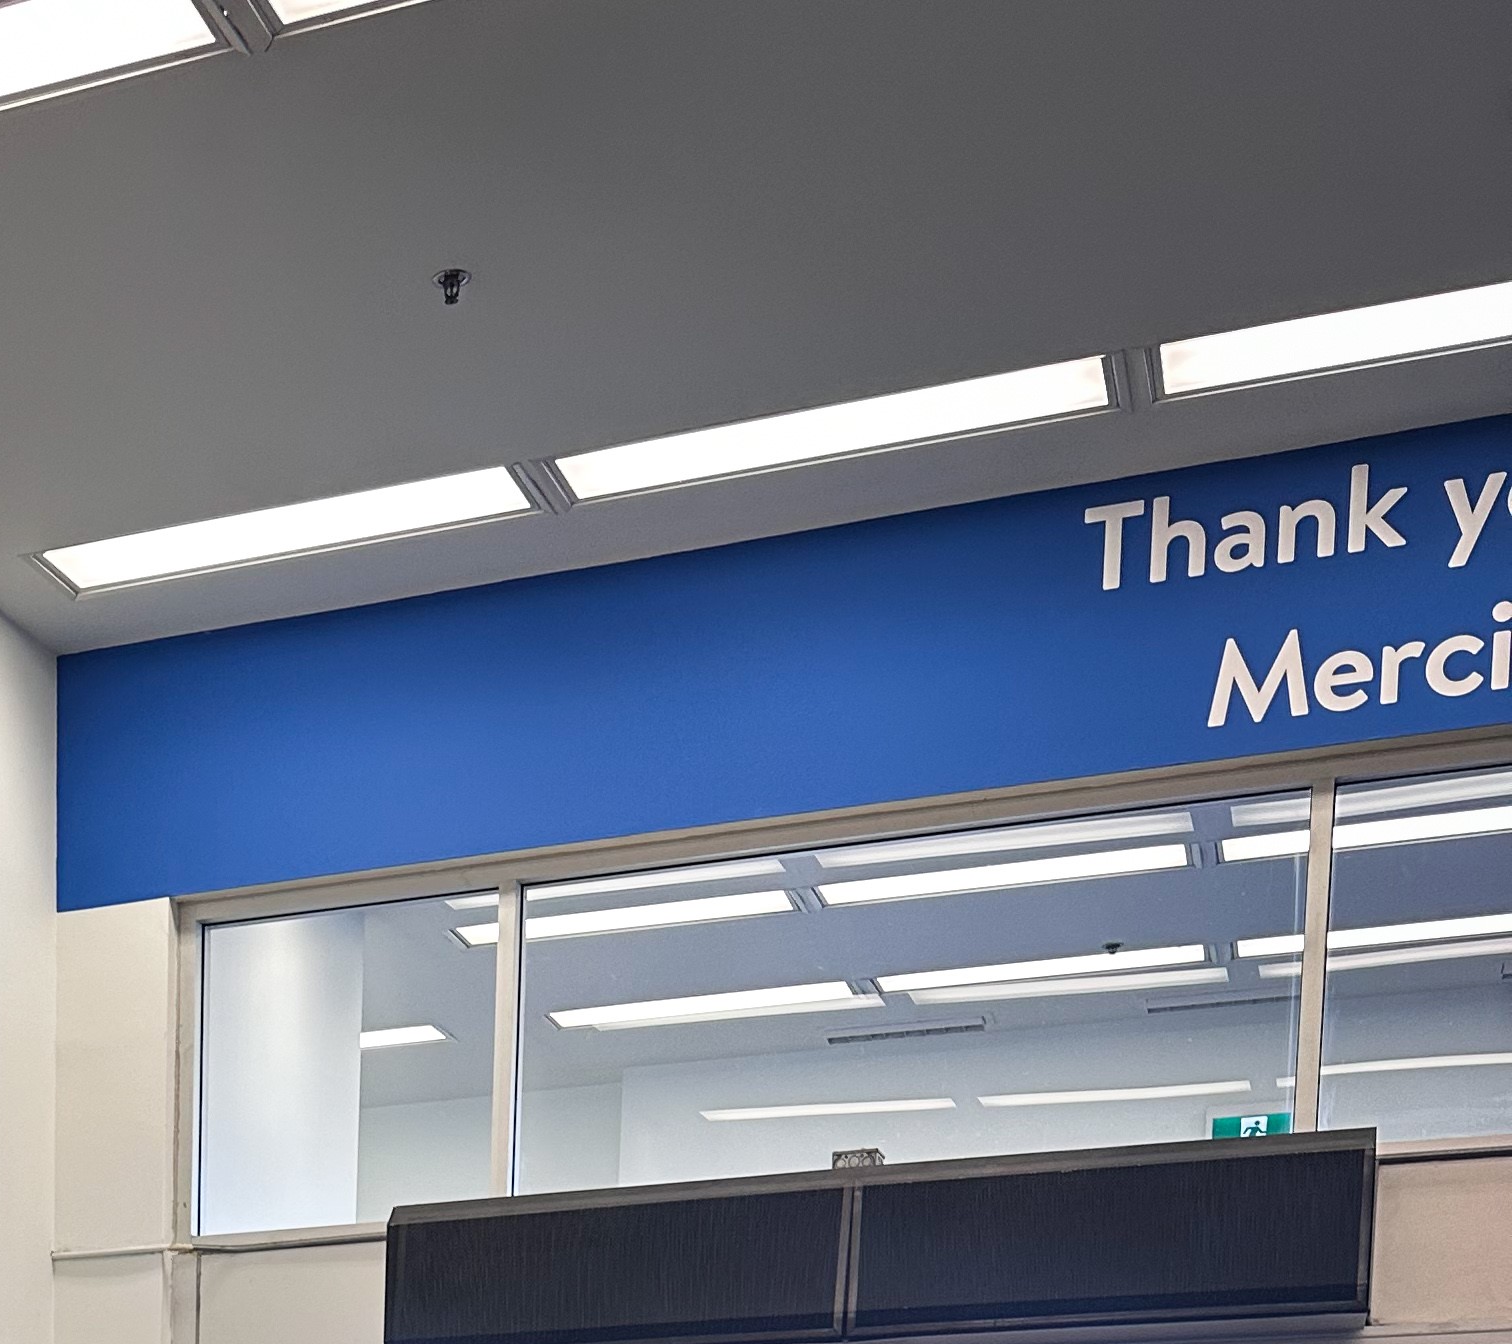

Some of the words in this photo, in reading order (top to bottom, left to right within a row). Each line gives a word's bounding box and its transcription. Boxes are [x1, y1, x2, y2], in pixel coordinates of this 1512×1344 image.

[1084, 464, 1408, 590] Thank
[1444, 471, 1512, 568] y
[1207, 600, 1512, 728] Merci
